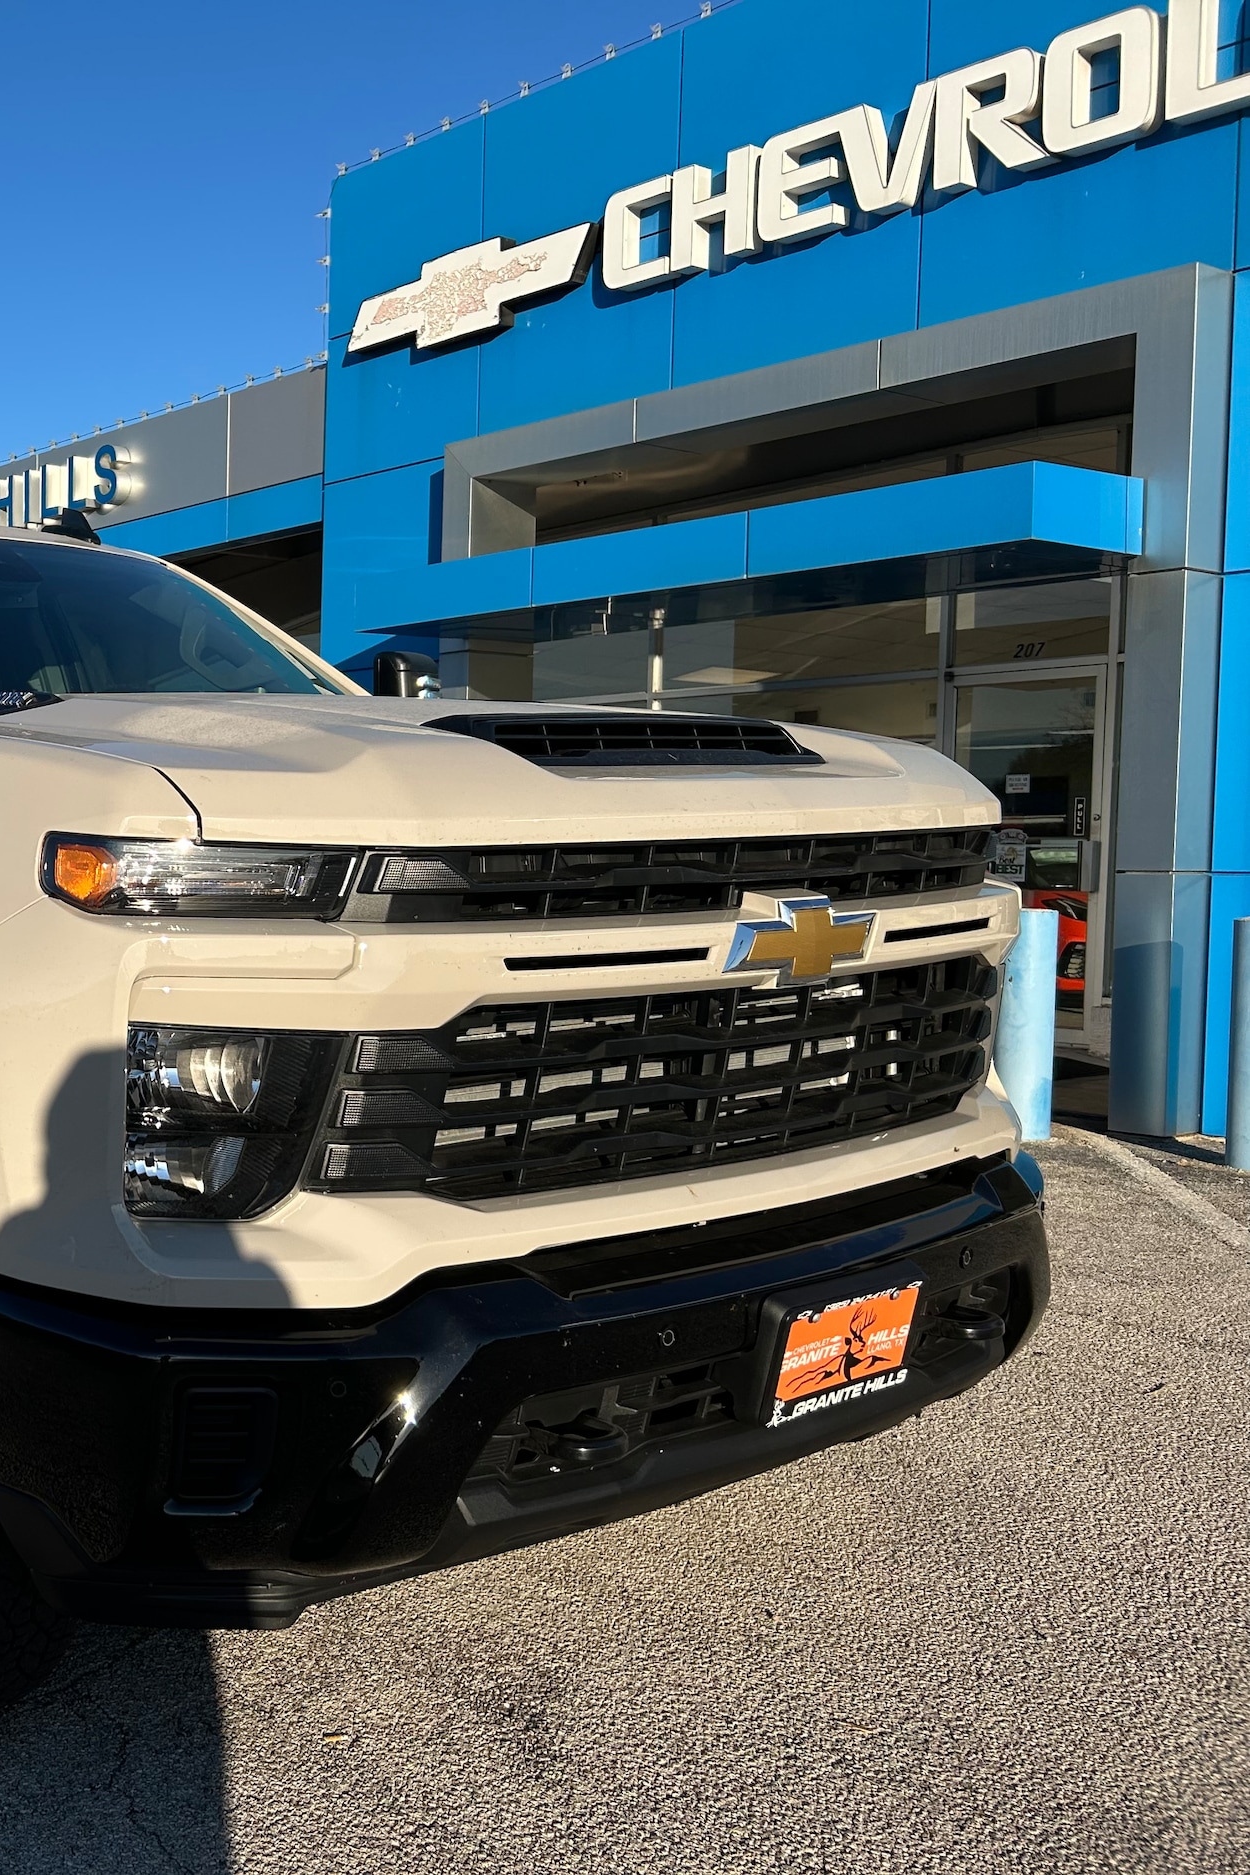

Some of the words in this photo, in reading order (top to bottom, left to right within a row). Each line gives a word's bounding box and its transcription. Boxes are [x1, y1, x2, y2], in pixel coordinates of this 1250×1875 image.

[1013, 641, 1046, 659] 207
[1076, 803, 1084, 830] PULL
[867, 1324, 910, 1346] HILLS
[894, 1338, 905, 1347] TX
[793, 1338, 831, 1356] CHEVROLET
[792, 1382, 865, 1417] GRANITE
[863, 1368, 908, 1395] HILLS
